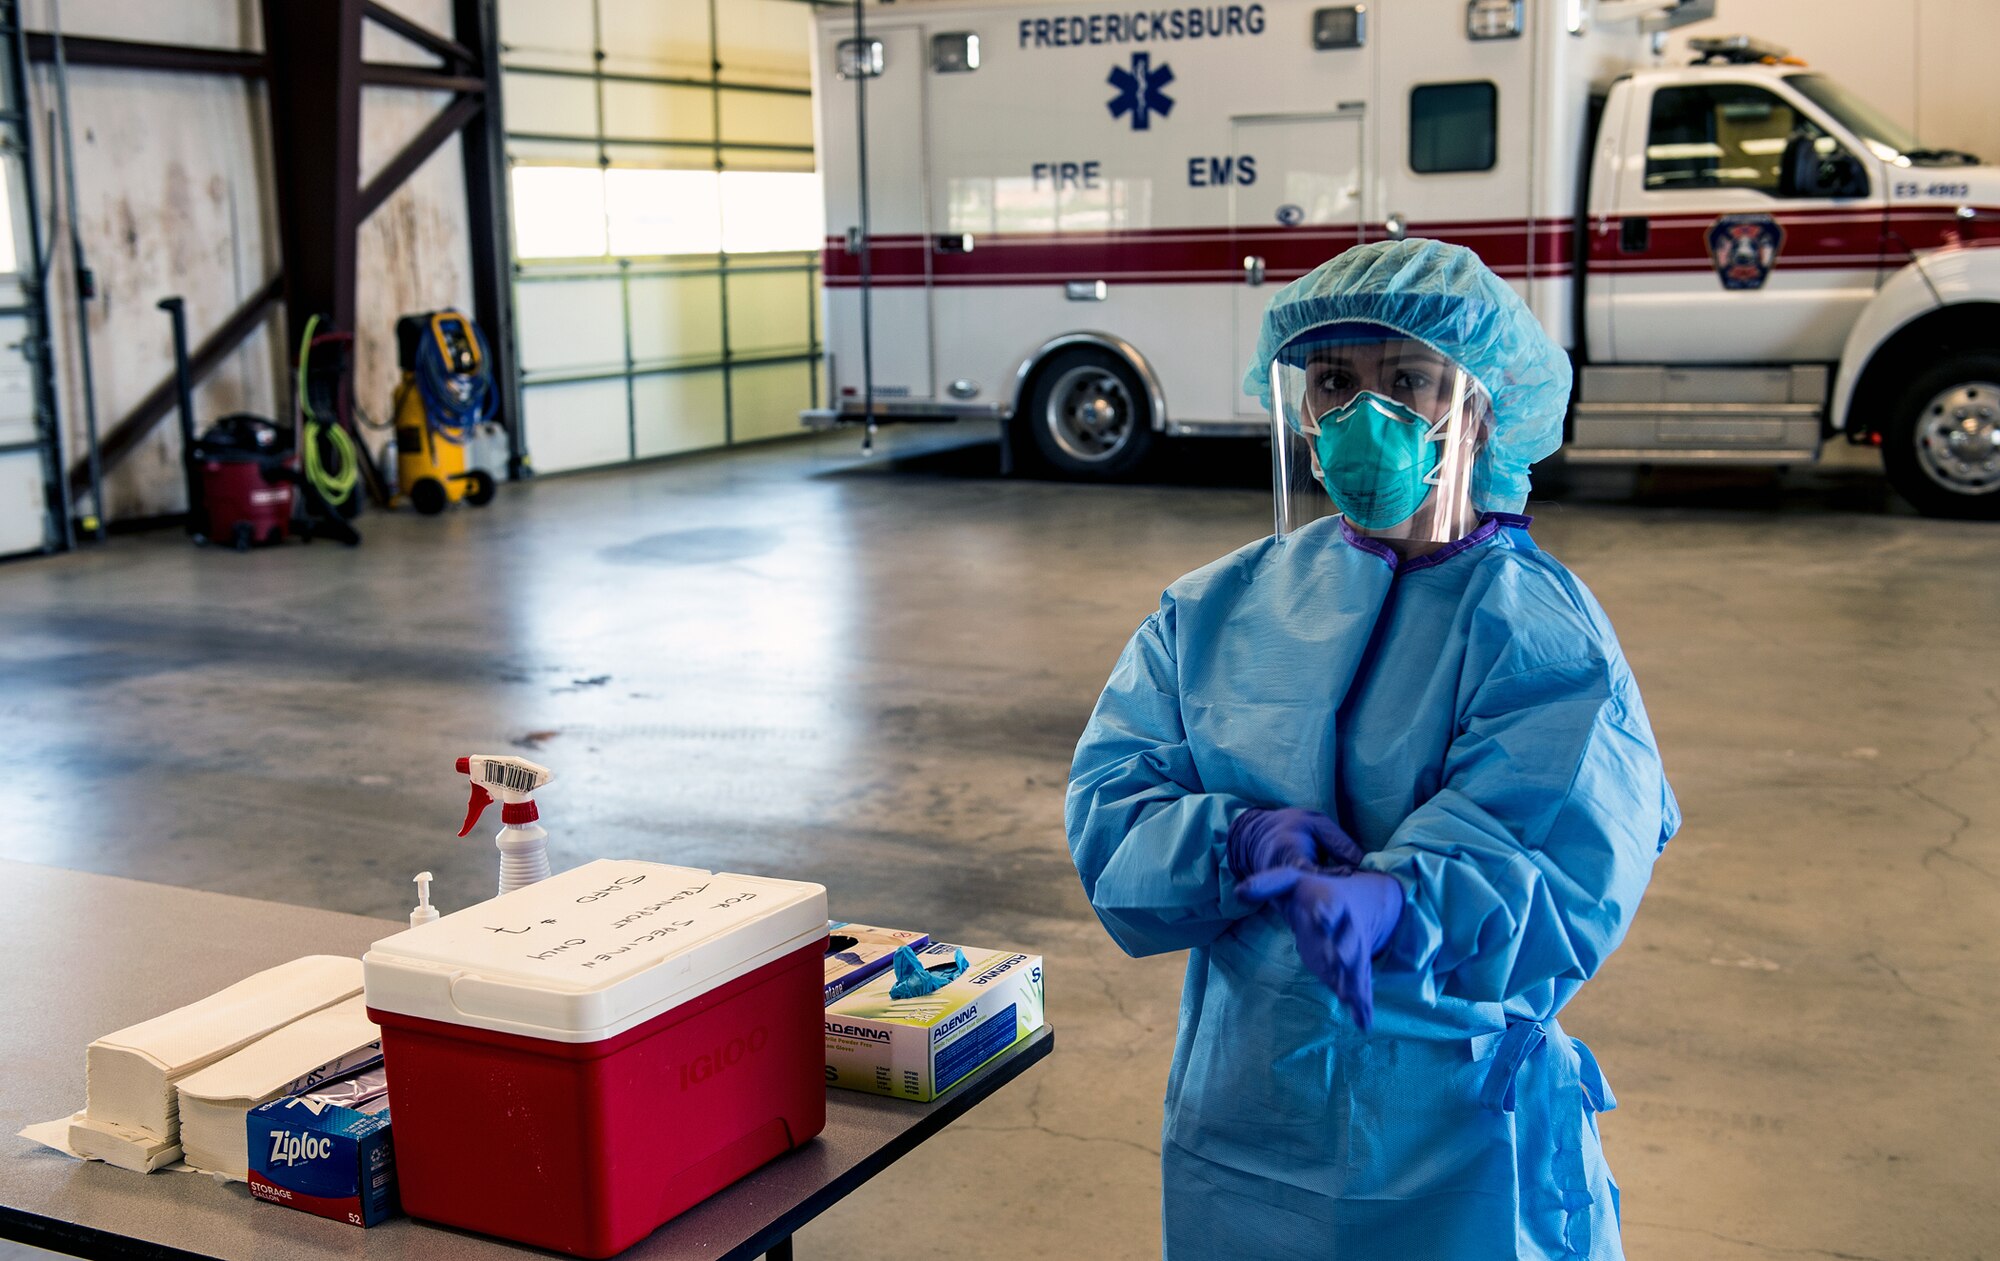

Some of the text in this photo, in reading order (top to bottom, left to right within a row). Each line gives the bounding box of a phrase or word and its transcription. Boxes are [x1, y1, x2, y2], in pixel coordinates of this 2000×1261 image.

[1019, 4, 1265, 48] FREDERICKSBURG
[1032, 155, 1257, 192] FIRE EMS
[576, 875, 646, 904] SAFD
[526, 883, 711, 960] TRANSPORT ONLY
[582, 892, 757, 968] FOR SPECIMEN
[973, 954, 1027, 985] ADENNA
[1031, 967, 1041, 983] S
[934, 1005, 978, 1041] ADENNA
[681, 1025, 768, 1092] IGLOO
[270, 1130, 331, 1167] Ziploc
[250, 1182, 293, 1200] STORAGE
[348, 1212, 362, 1225] 52
